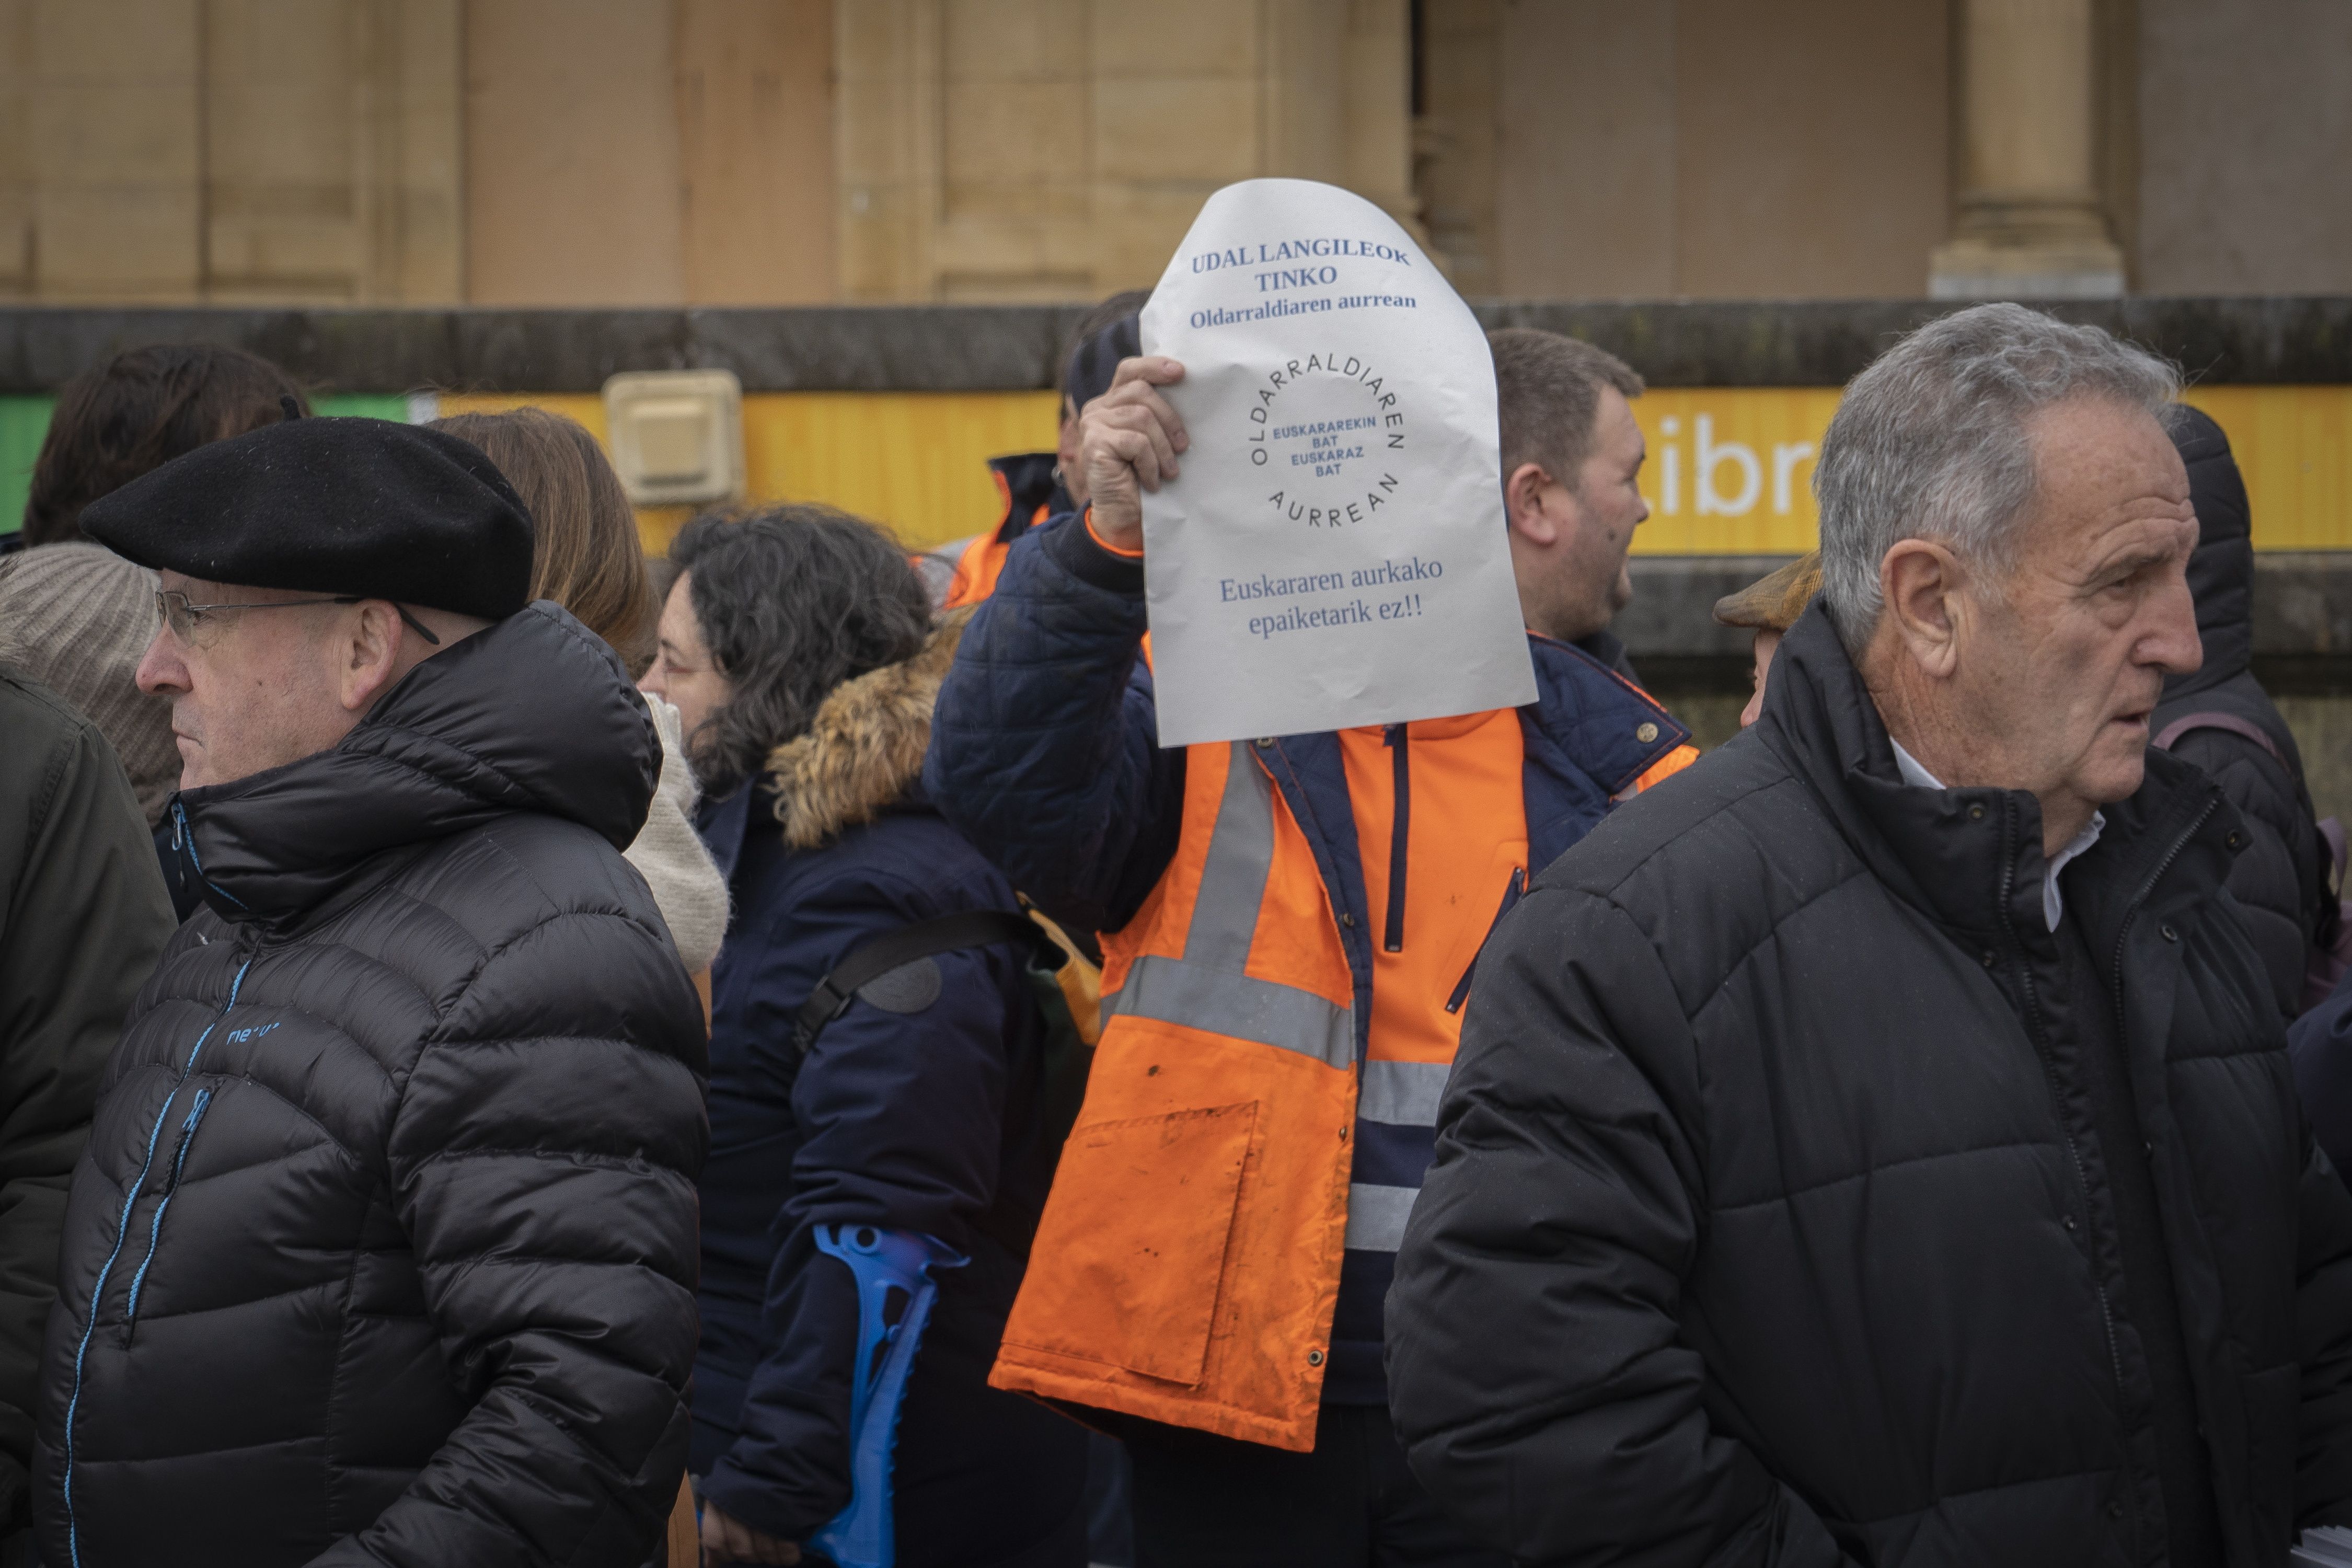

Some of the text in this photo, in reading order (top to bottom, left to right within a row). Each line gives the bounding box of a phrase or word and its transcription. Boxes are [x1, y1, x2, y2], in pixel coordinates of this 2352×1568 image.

[1193, 238, 1411, 274] UDAL LANGILEOK
[1255, 266, 1338, 292] TINKO
[1190, 295, 1417, 329] Oldarraldiaren aurrean
[1249, 353, 1405, 466] OLDARRALDIAREN
[1273, 417, 1377, 440] EUSKARAREKIN
[1312, 435, 1338, 448] BAT
[1291, 446, 1364, 466] EUSKARAZ
[1315, 464, 1341, 477] BAT
[1644, 413, 1814, 514] ibr
[1269, 473, 1399, 527] AURREAN
[1220, 557, 1443, 602] Euskararen aurkako
[1249, 593, 1422, 639] epaiketarik ez!!
